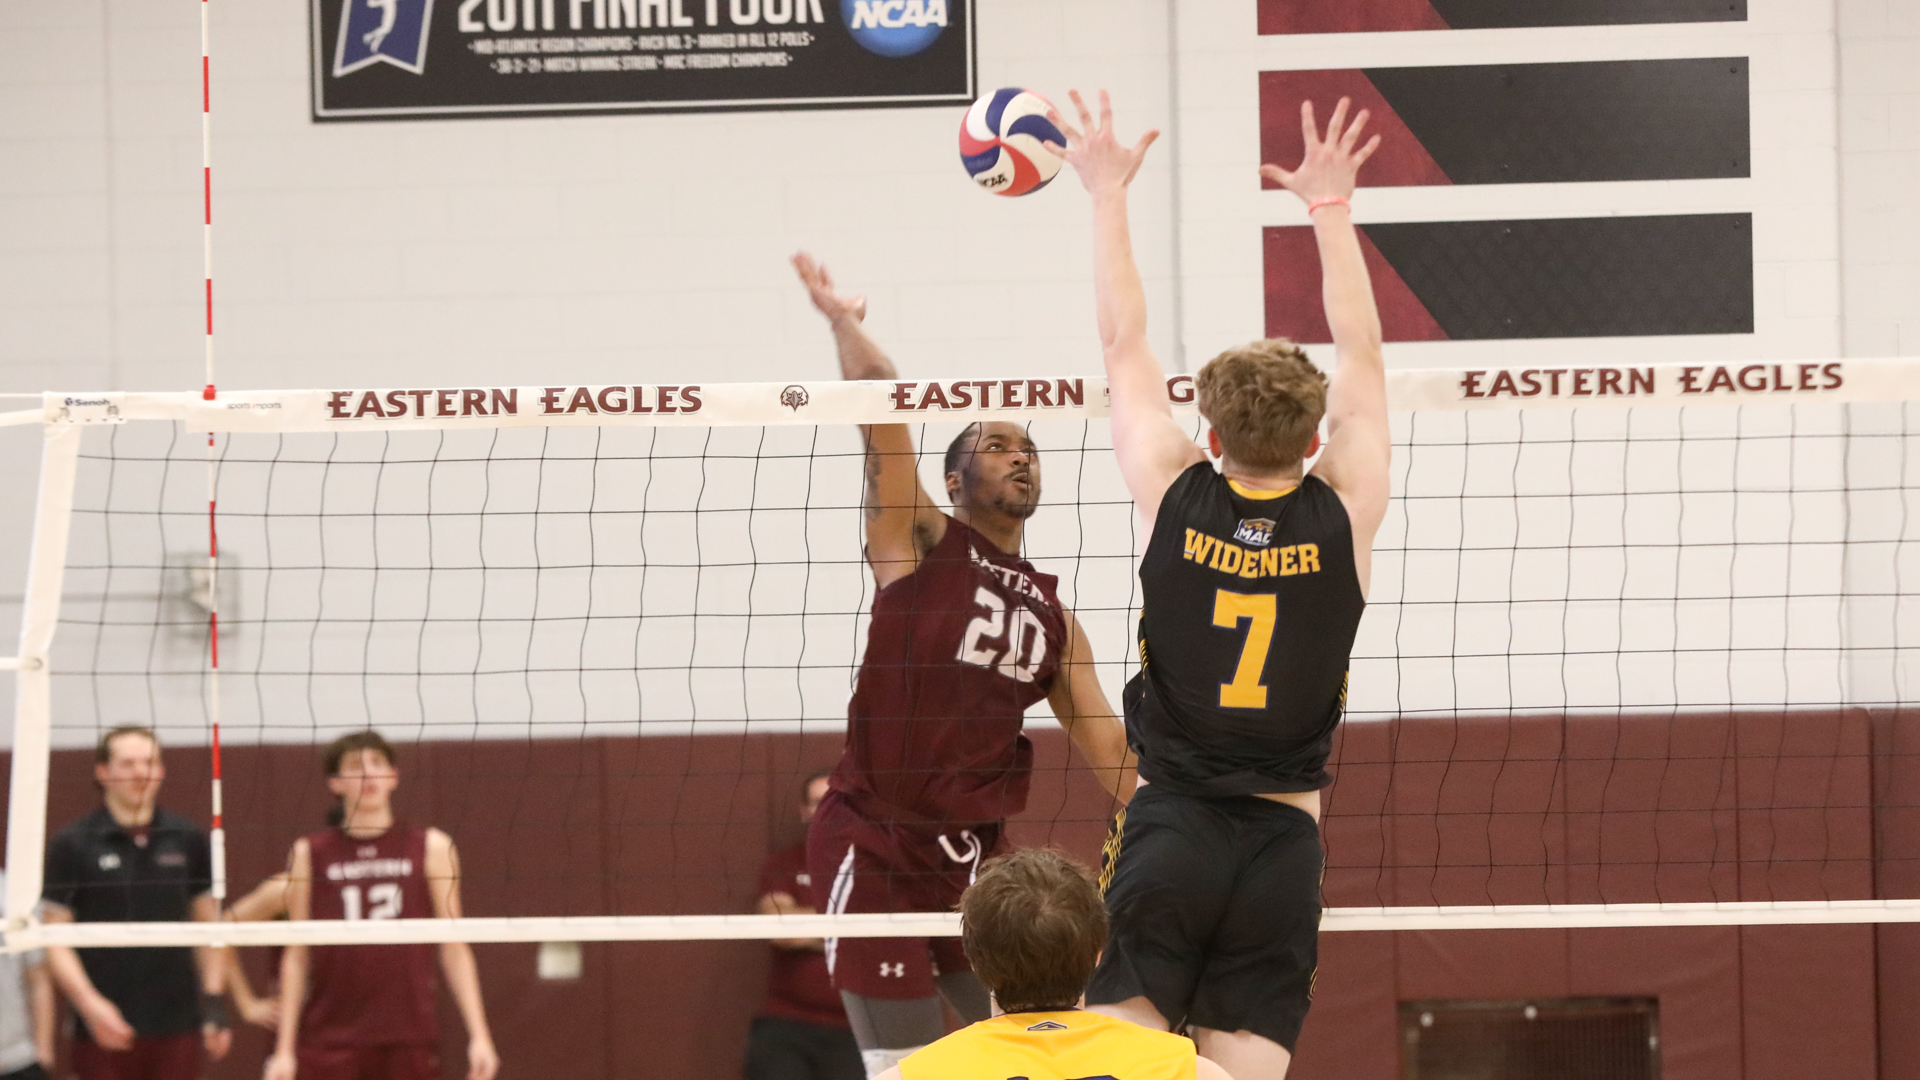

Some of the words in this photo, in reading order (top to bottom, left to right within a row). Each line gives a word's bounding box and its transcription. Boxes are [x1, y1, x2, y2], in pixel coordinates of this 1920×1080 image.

[851, 0, 949, 29] NCAA
[576, 36, 634, 52] CHAMPIONS
[737, 33, 749, 47] IN
[768, 32, 779, 47] 12
[780, 32, 811, 47] POLLS
[731, 52, 788, 68] CHAMPIONS
[890, 378, 1084, 411] EASTERN
[1460, 366, 1656, 398] EASTERN
[1678, 362, 1844, 394] EAGLES
[326, 388, 518, 420] EASTERN
[538, 385, 703, 415] EAGLES
[1183, 527, 1321, 579] WIDENER
[956, 585, 1047, 683] 20
[1211, 587, 1278, 709] 7
[341, 883, 403, 920] 12
